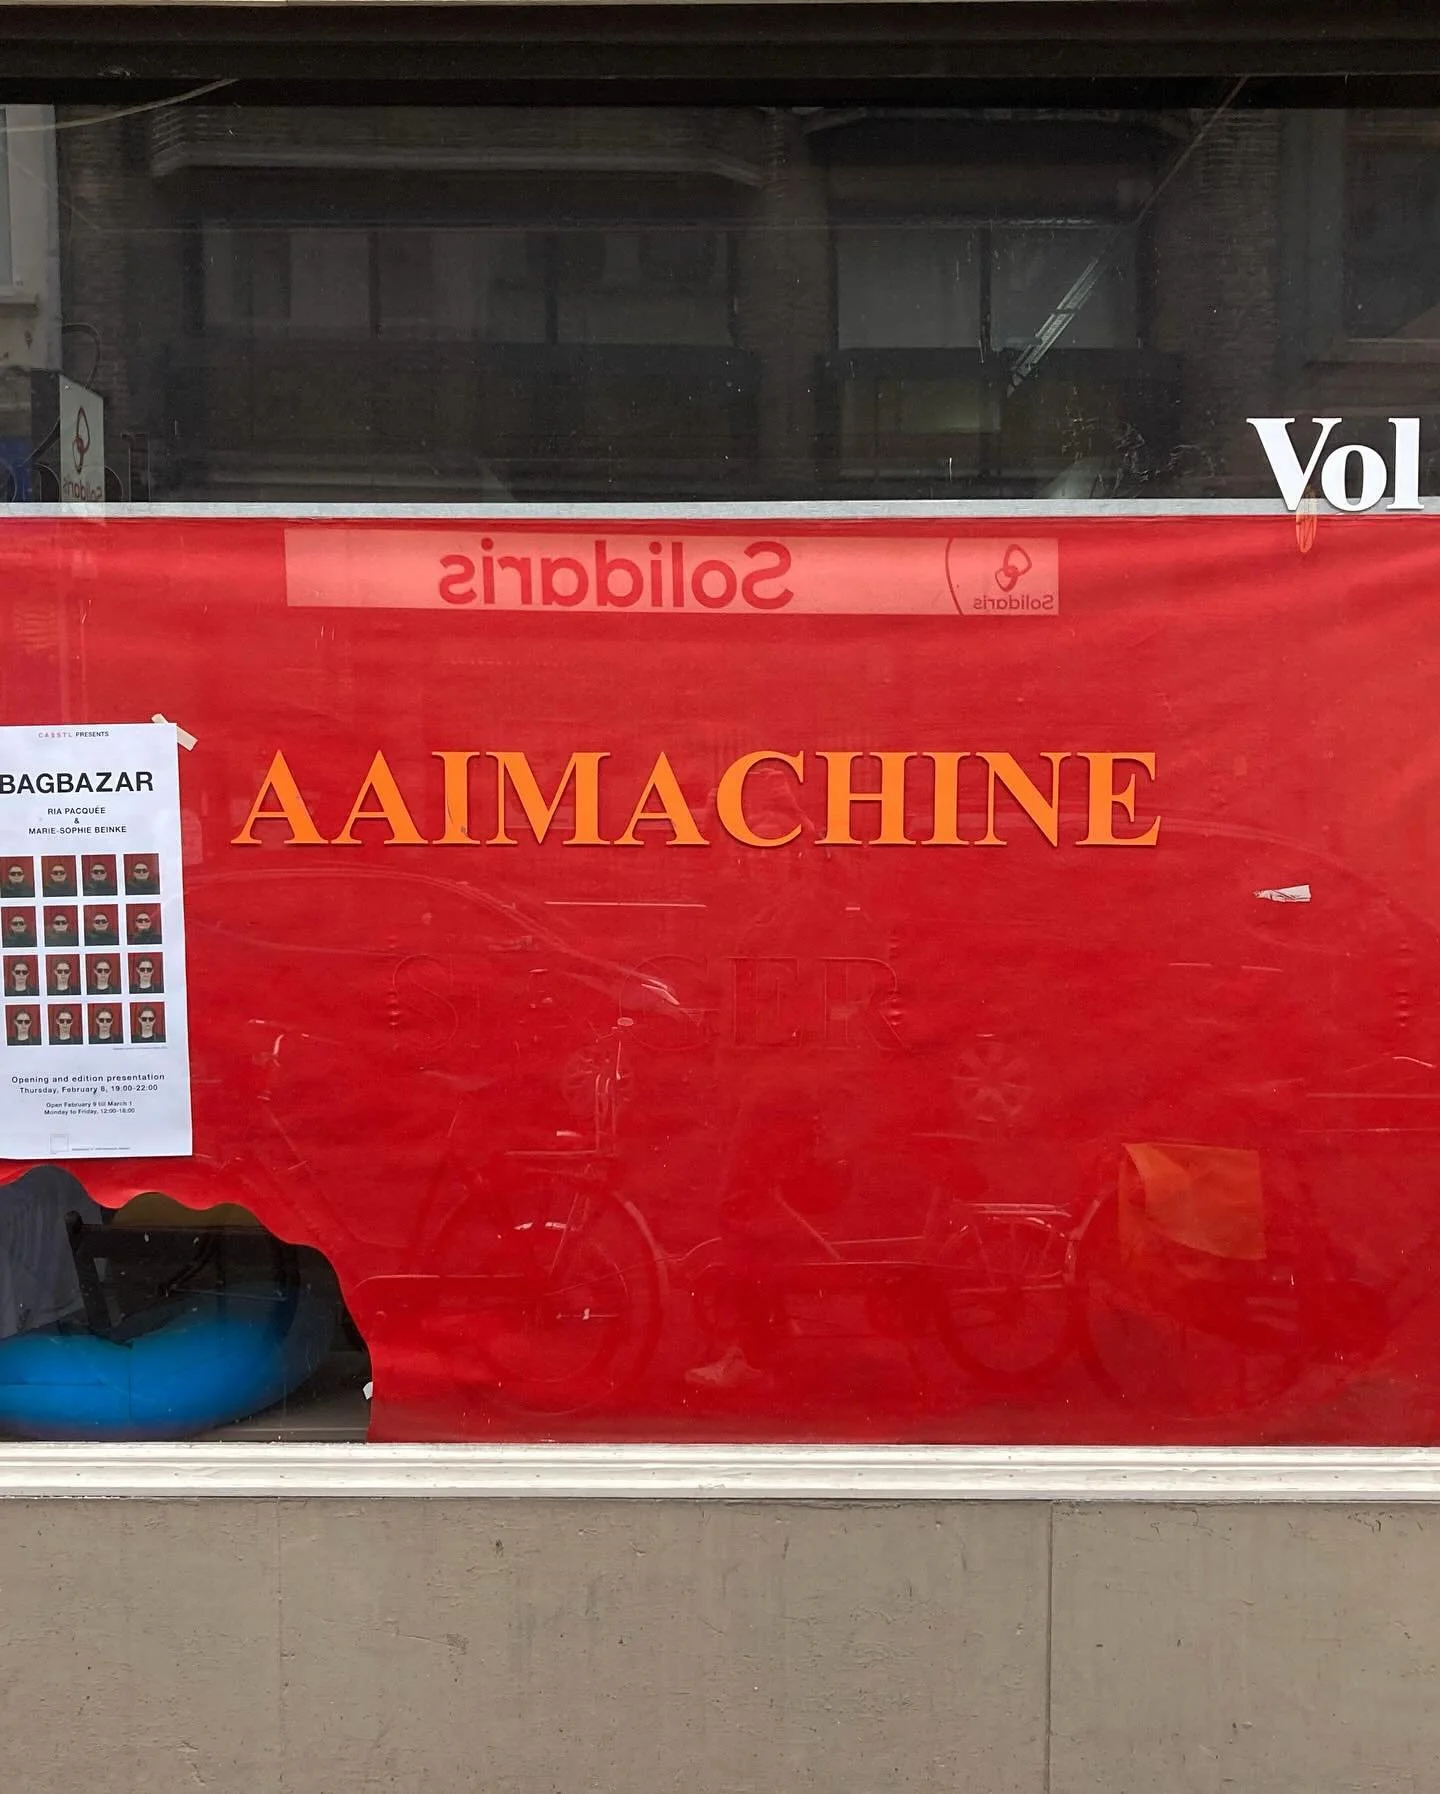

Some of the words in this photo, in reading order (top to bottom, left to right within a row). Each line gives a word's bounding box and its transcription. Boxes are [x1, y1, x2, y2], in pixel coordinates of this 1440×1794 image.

[1246, 417, 1425, 512] Vol
[0, 771, 153, 794] BAGBAZAR
[230, 749, 1161, 848] AAIMACHINE
[47, 807, 62, 815] RIA
[64, 806, 106, 815] PACQUÉE
[28, 827, 92, 835] MARIE-SOPHIE
[94, 826, 127, 834] BEINKE
[11, 1076, 49, 1084] Opening
[71, 1074, 104, 1082] edition
[106, 1074, 165, 1082] presentation
[61, 1086, 98, 1094] February
